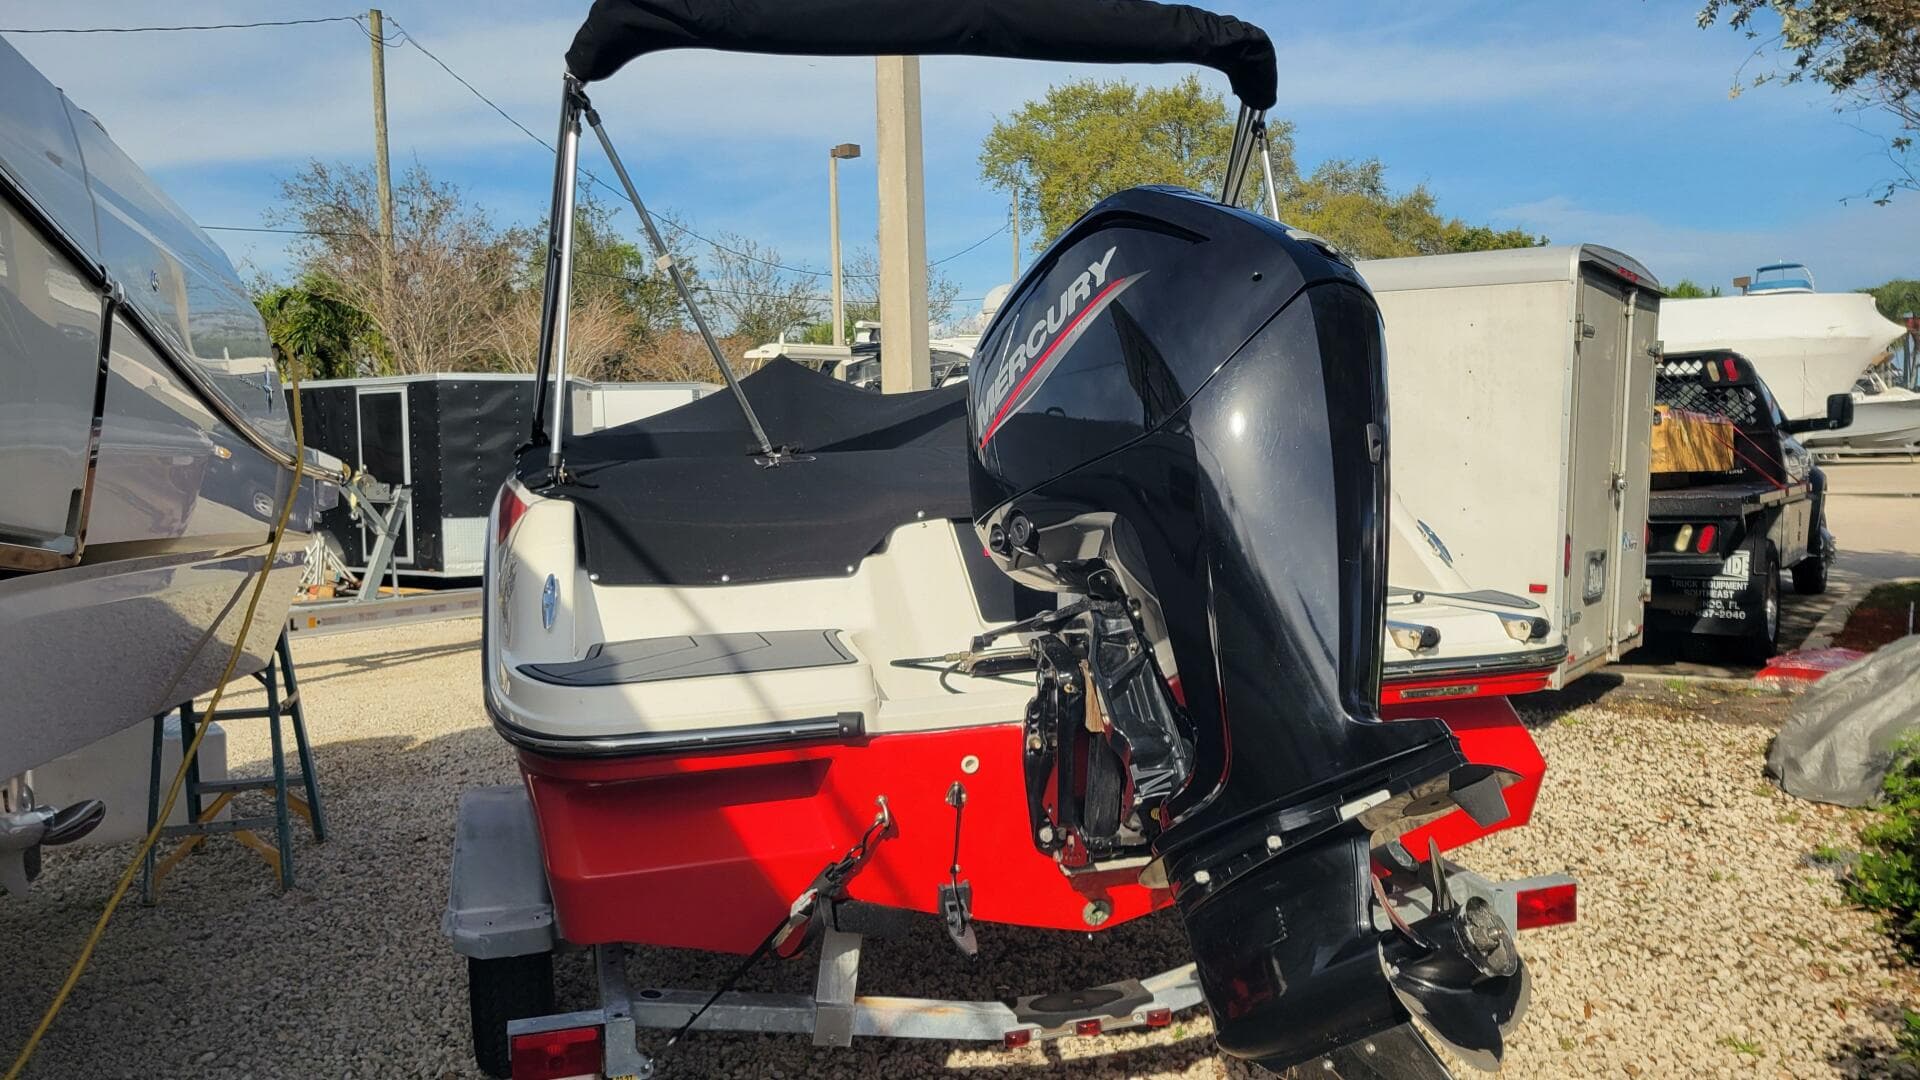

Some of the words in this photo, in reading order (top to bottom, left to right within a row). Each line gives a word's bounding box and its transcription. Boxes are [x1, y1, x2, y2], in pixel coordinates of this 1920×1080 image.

[978, 246, 1117, 437] MERCURY
[1671, 579, 1698, 589] TRUCK
[1702, 580, 1748, 591] EQUIPMENT
[1684, 588, 1735, 599] SOUTHEAST
[1728, 601, 1741, 610] FL
